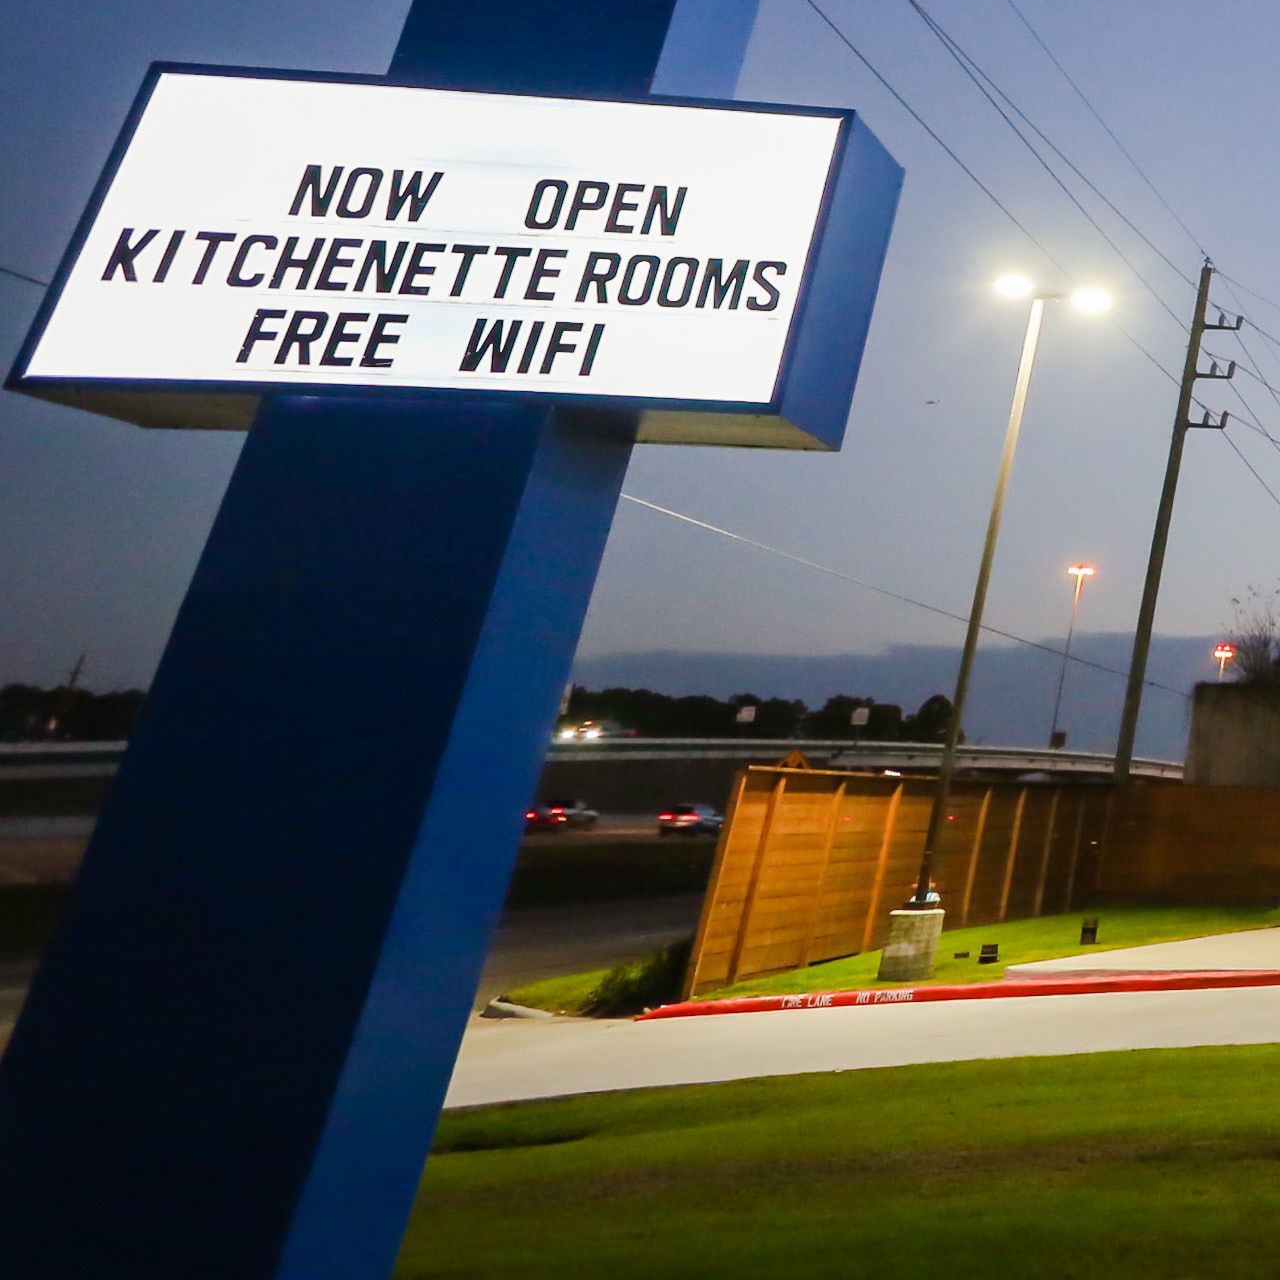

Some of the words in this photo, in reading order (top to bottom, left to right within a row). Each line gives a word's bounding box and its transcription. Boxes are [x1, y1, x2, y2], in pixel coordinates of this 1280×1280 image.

[288, 164, 445, 223] NOW
[524, 179, 688, 236] OPEN
[100, 227, 569, 301] KITCHENETTE
[574, 251, 788, 312] ROOMS
[235, 308, 410, 368] FREE
[458, 318, 606, 377] WIFI
[781, 995, 804, 1009] FIRE
[807, 993, 834, 1008] LANE
[855, 991, 870, 1004] NO
[874, 989, 915, 1003] PARKING
